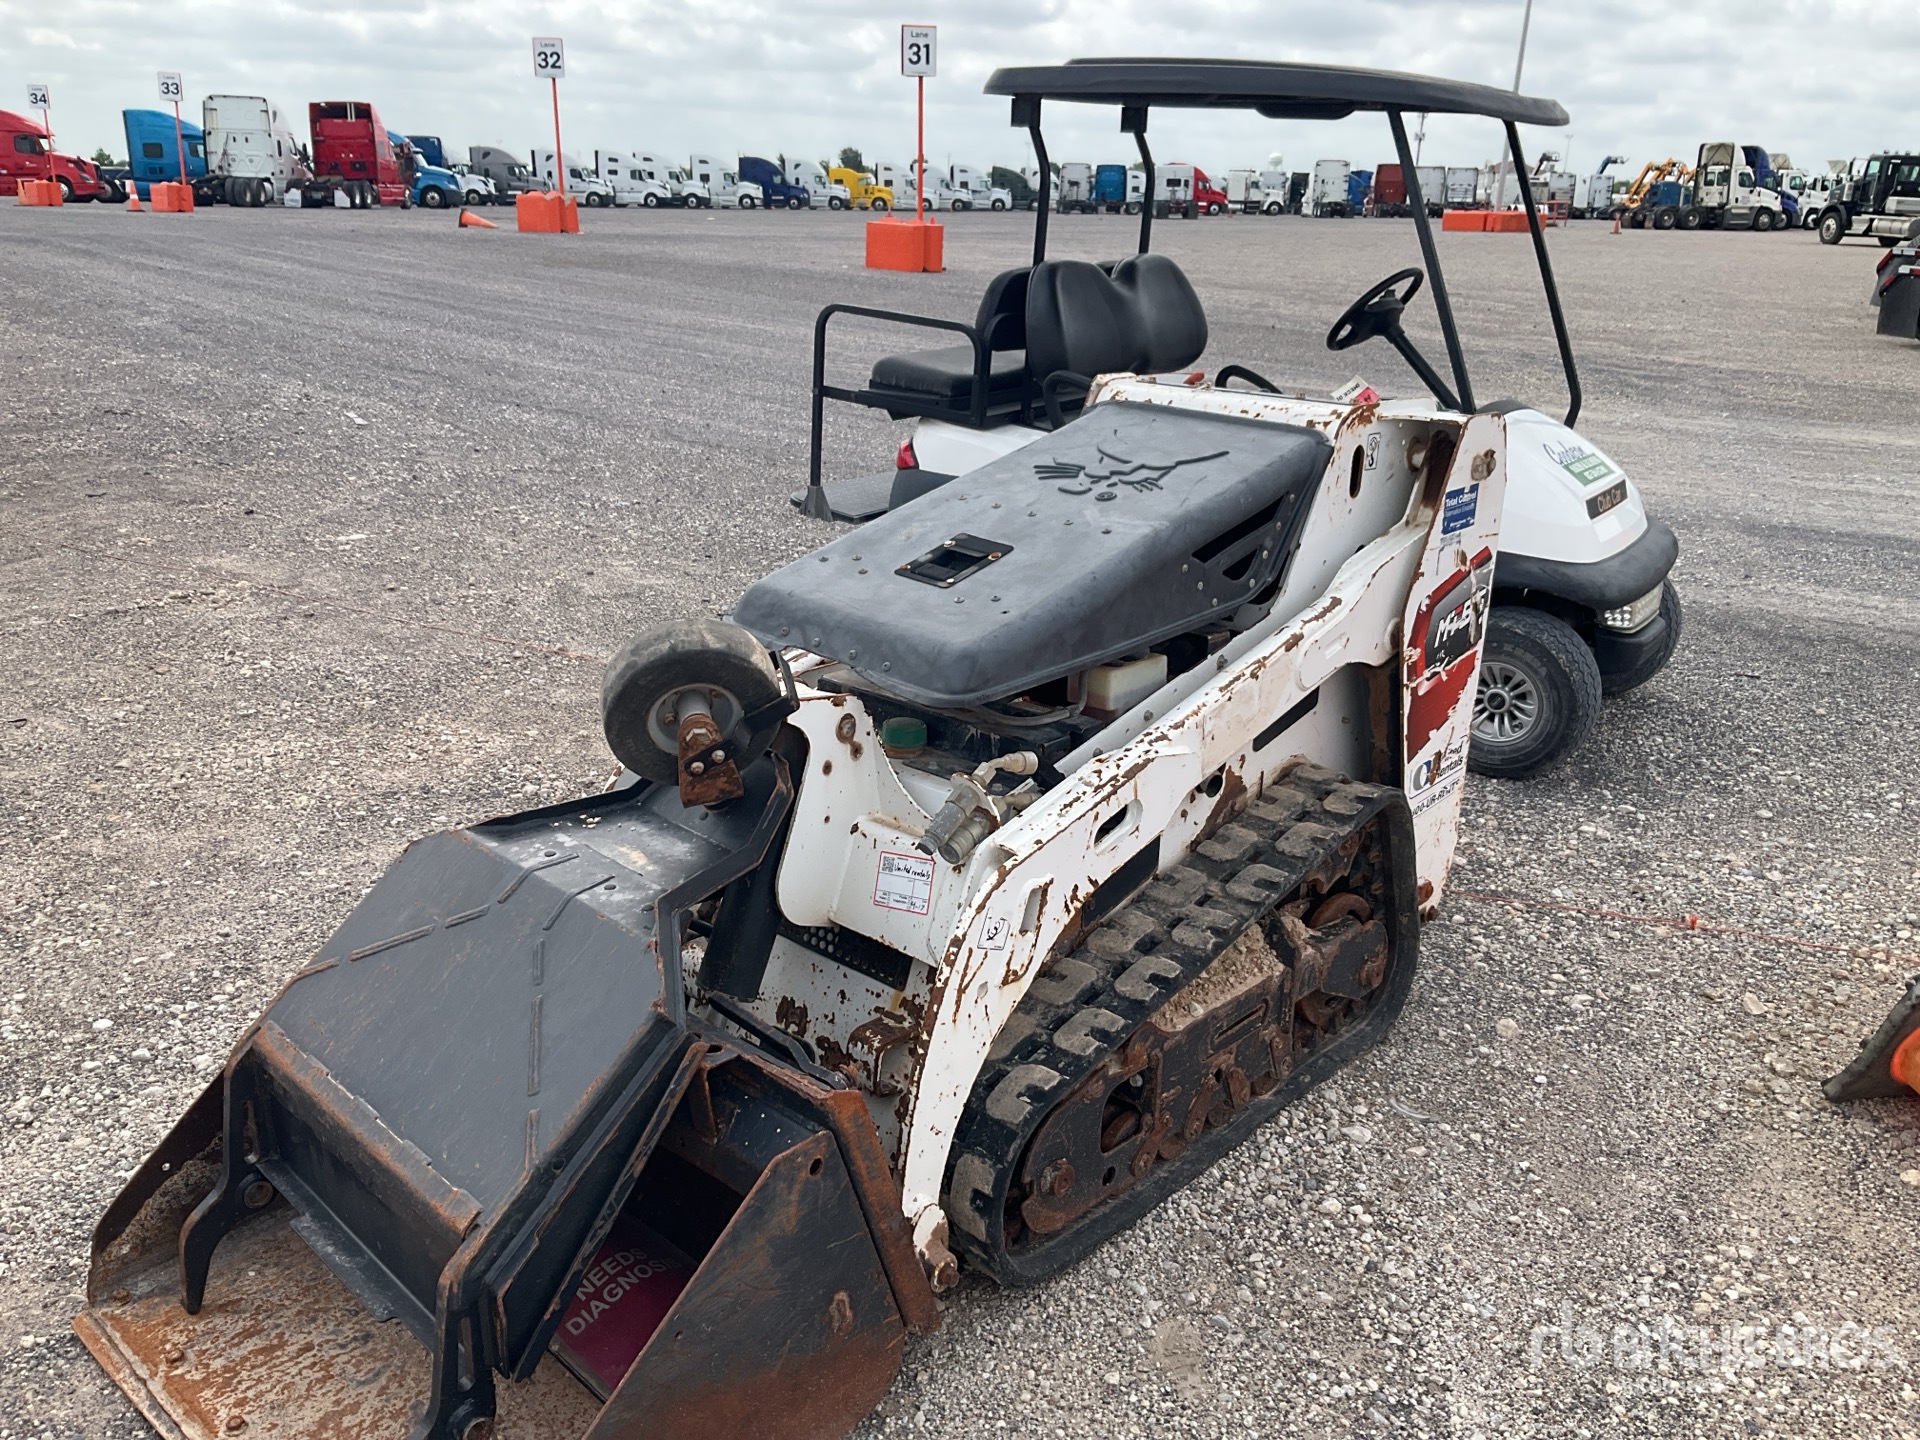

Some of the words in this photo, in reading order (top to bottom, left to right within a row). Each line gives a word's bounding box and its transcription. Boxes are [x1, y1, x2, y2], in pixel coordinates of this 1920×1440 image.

[910, 30, 929, 38] Lane
[537, 51, 562, 69] 32
[908, 42, 930, 65] 31
[161, 82, 180, 95] 33
[29, 93, 47, 104] 34
[1445, 496, 1458, 508] Total
[1437, 756, 1464, 778] entals
[575, 1248, 648, 1302] NEEDS
[565, 1257, 683, 1336] DIAGNOSIS
